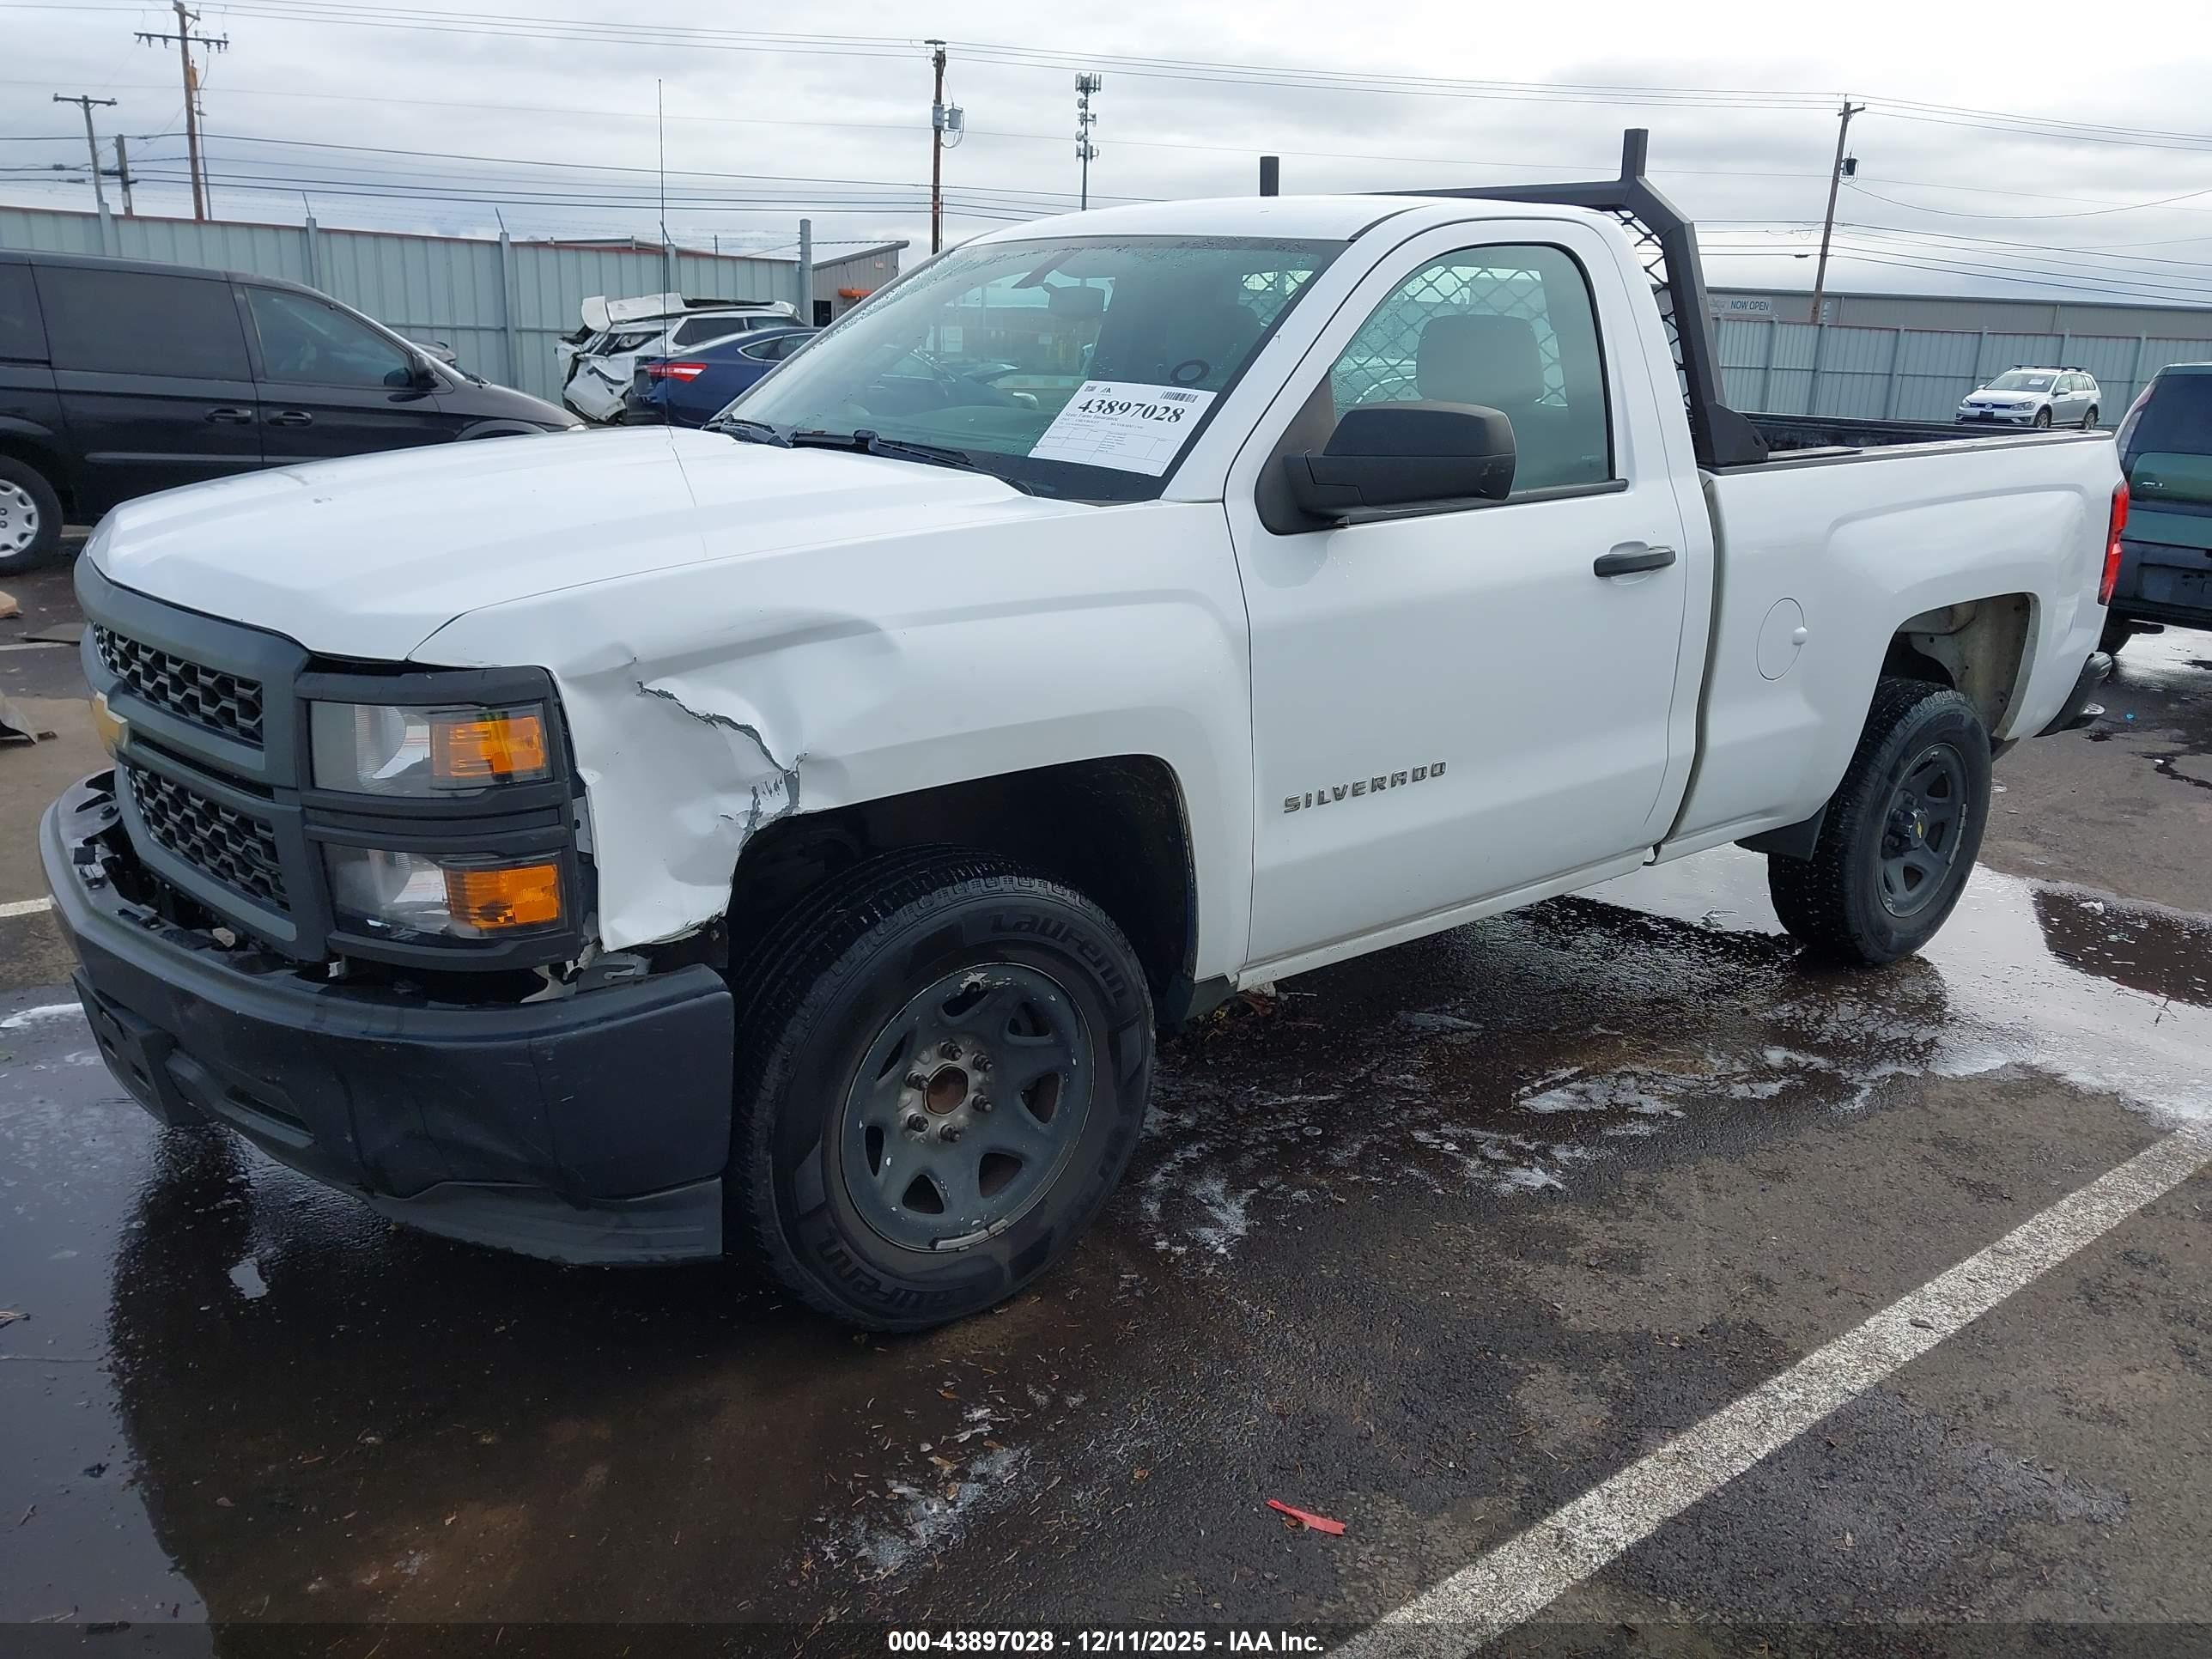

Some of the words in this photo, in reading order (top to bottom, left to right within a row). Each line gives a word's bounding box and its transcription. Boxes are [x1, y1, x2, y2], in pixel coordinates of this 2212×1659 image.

[1730, 301, 1749, 310] NOW
[1749, 301, 1769, 311] OPEN
[1078, 398, 1186, 424] 43897028
[1283, 760, 1448, 814] SILVERADO
